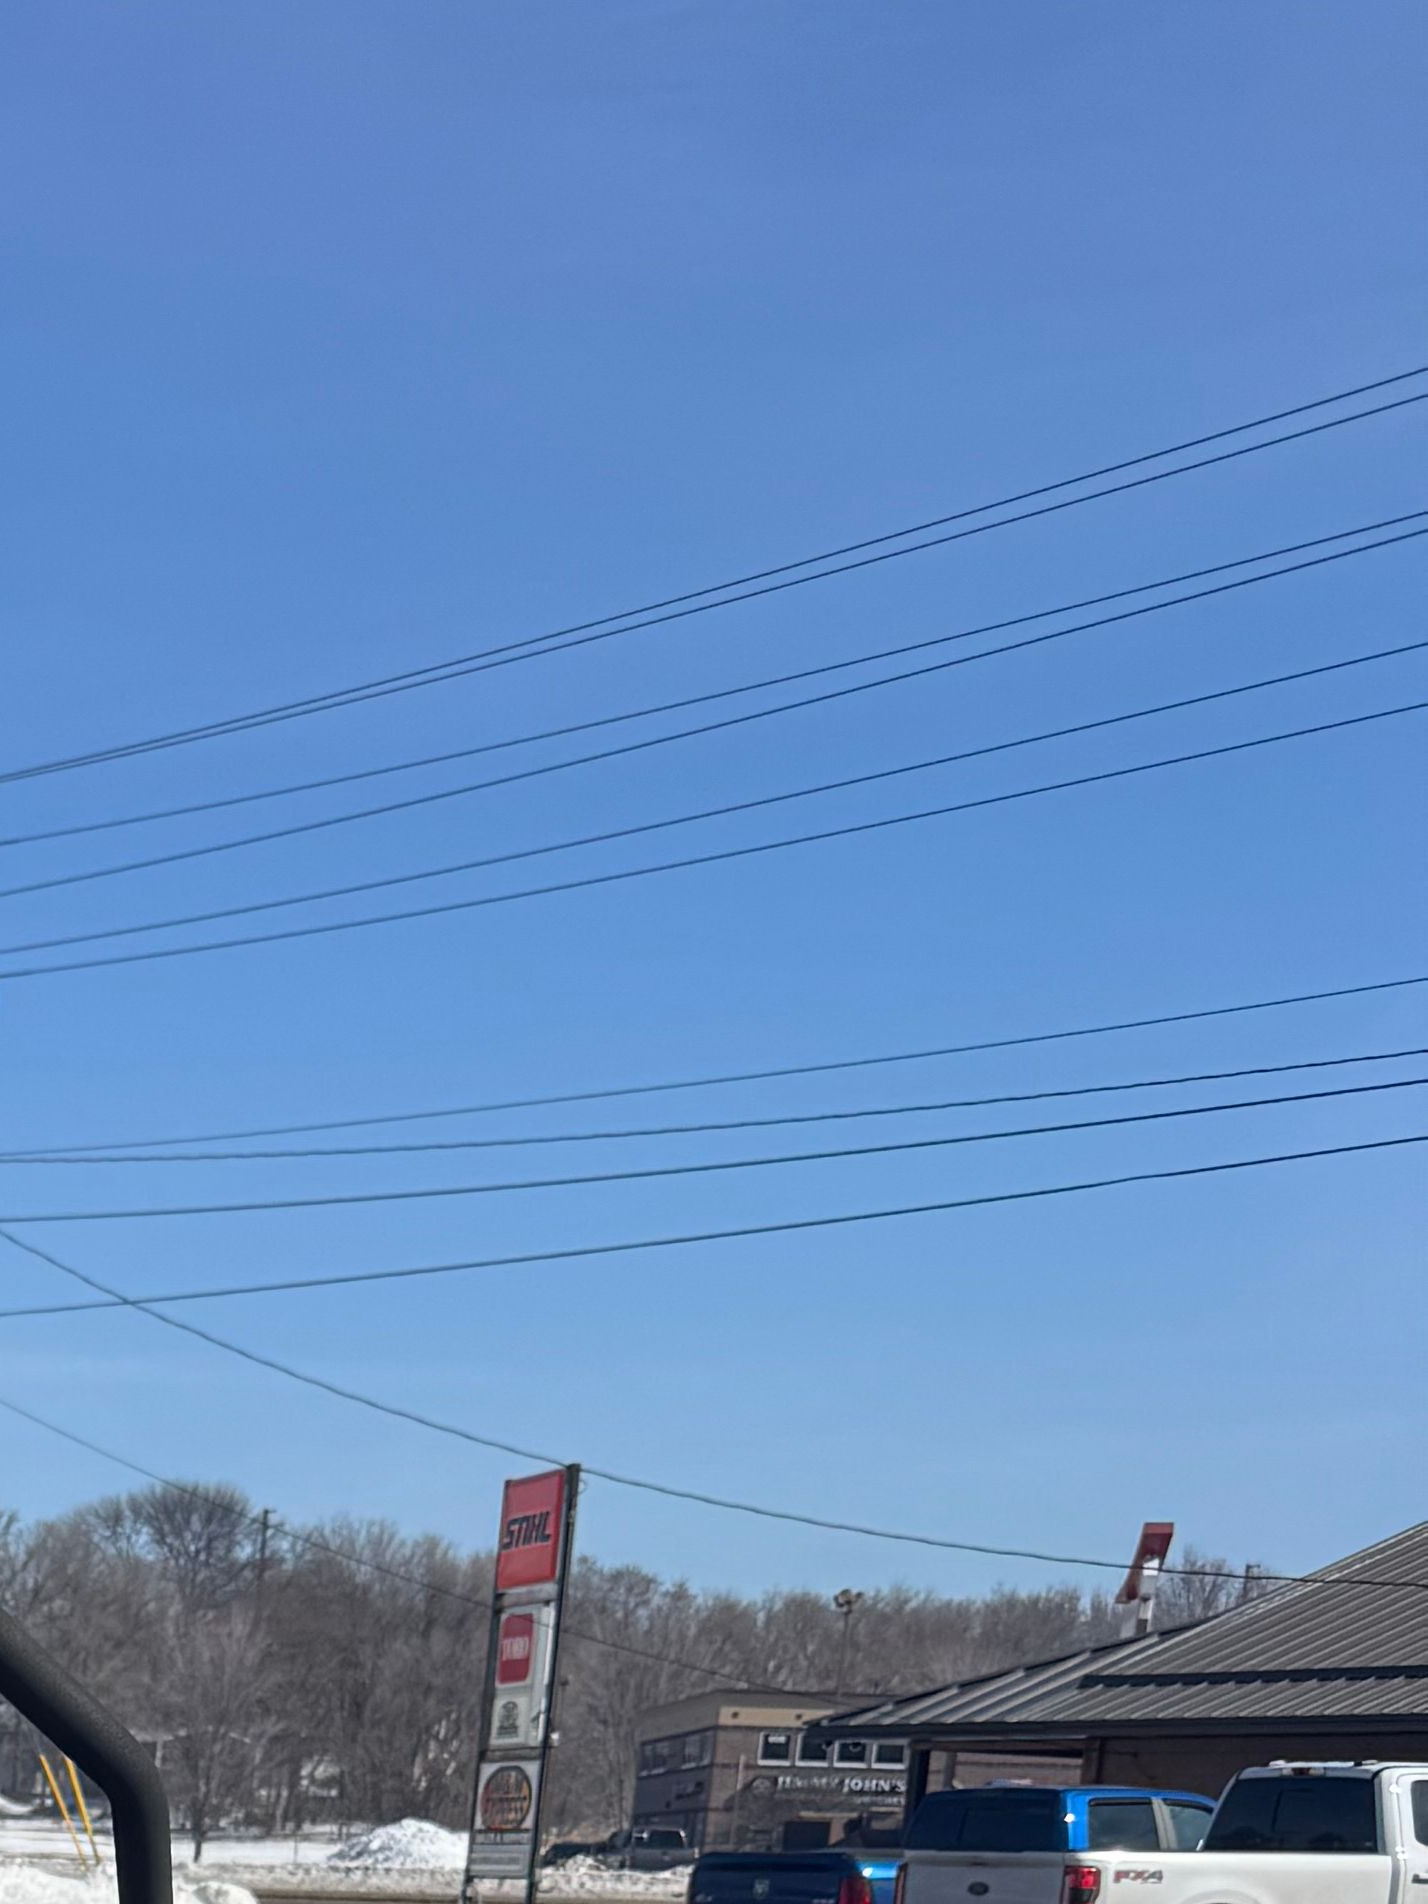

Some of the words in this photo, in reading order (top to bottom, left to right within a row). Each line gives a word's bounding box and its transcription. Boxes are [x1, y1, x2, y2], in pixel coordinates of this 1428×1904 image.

[502, 1511, 551, 1550] STIHL
[842, 1777, 907, 1793] JOHN'S
[1113, 1869, 1163, 1884] FX4
